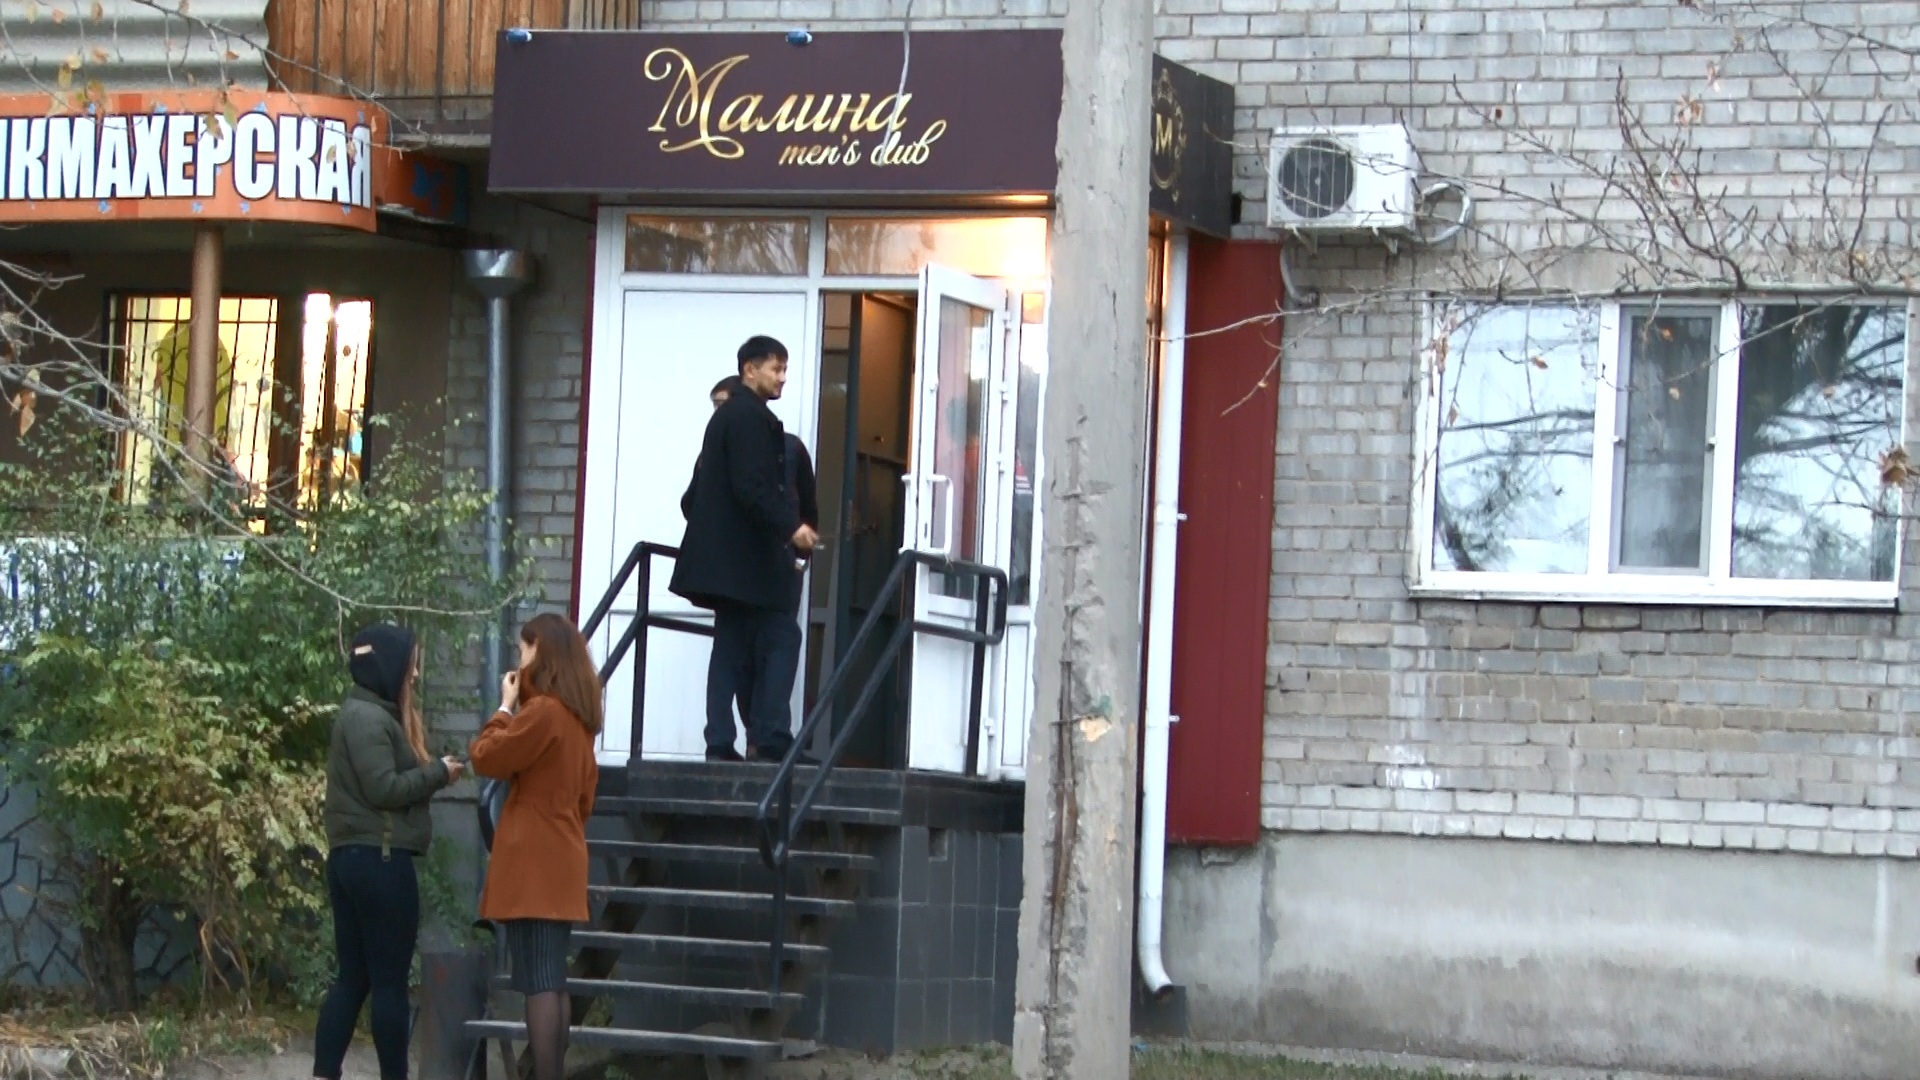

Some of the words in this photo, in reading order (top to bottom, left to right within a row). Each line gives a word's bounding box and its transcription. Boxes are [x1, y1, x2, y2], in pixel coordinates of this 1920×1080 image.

[644, 48, 914, 159] Малина
[778, 134, 861, 166] men's
[870, 119, 947, 167] club
[0, 112, 372, 208] КМАХЕРСКАЯ
